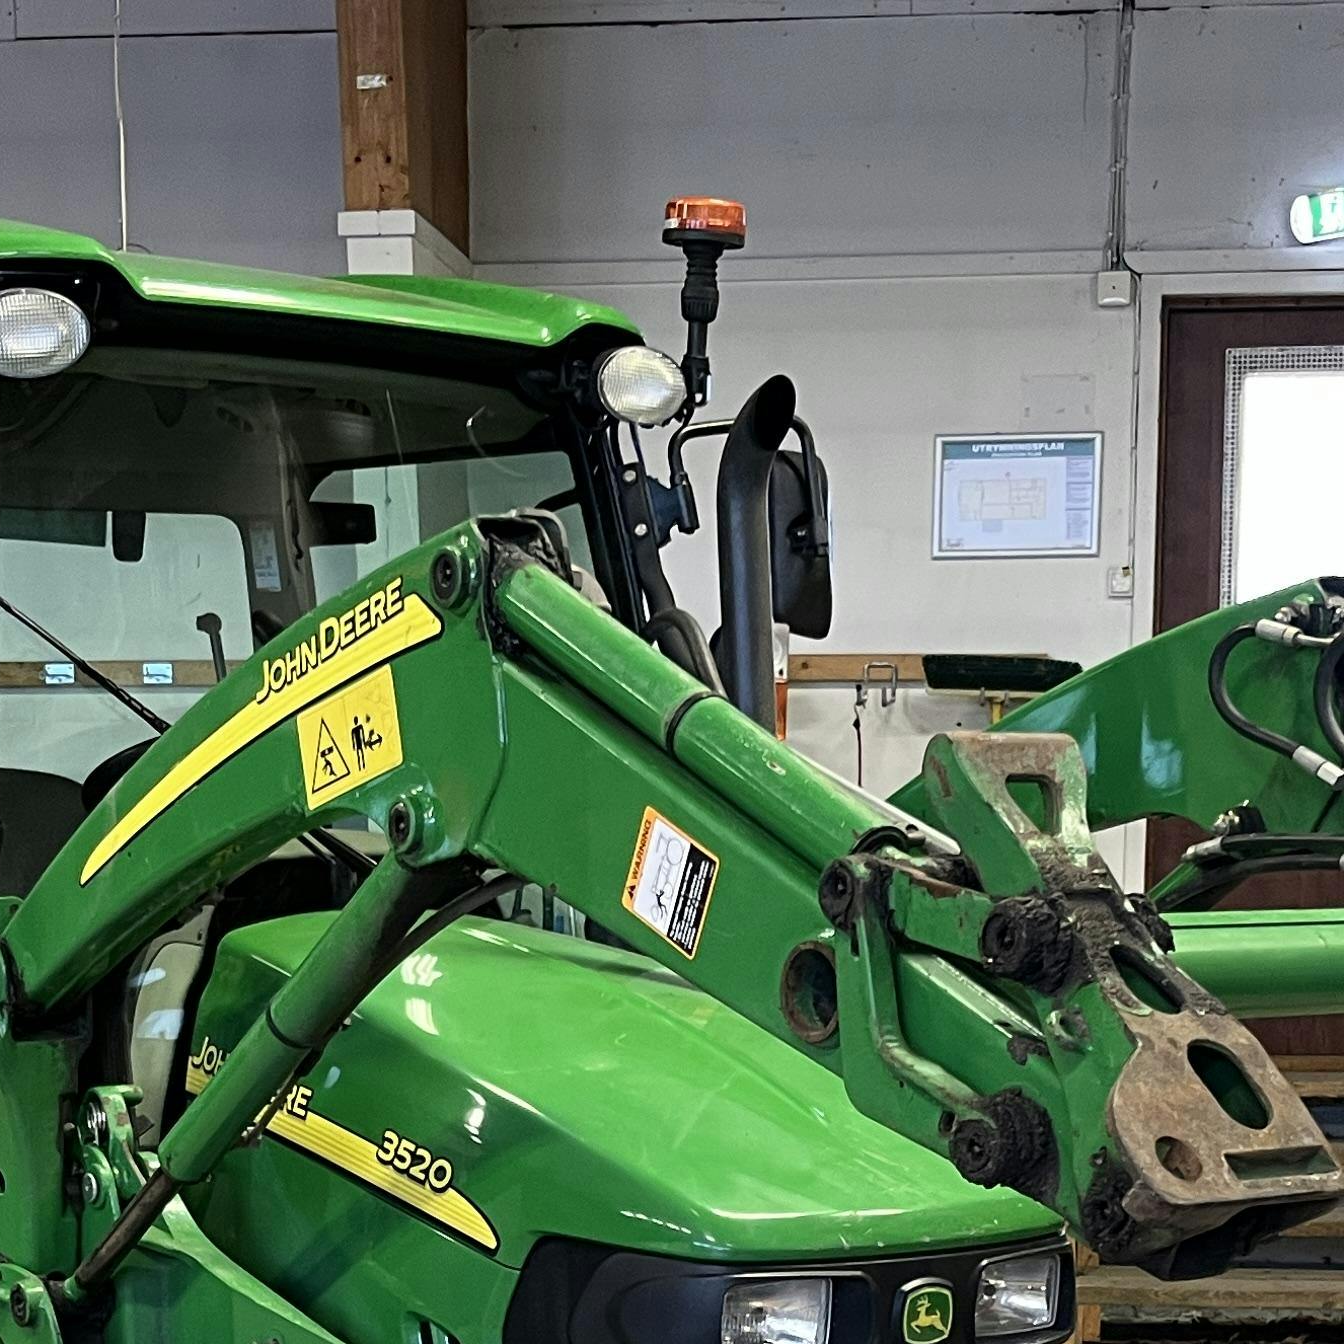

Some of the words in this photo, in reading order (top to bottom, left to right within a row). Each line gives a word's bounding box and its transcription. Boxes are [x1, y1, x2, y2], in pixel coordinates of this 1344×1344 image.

[256, 635, 319, 704] JOHN
[318, 576, 405, 661] DEERE
[631, 819, 652, 881] WARNING
[375, 1127, 453, 1194] 3520
